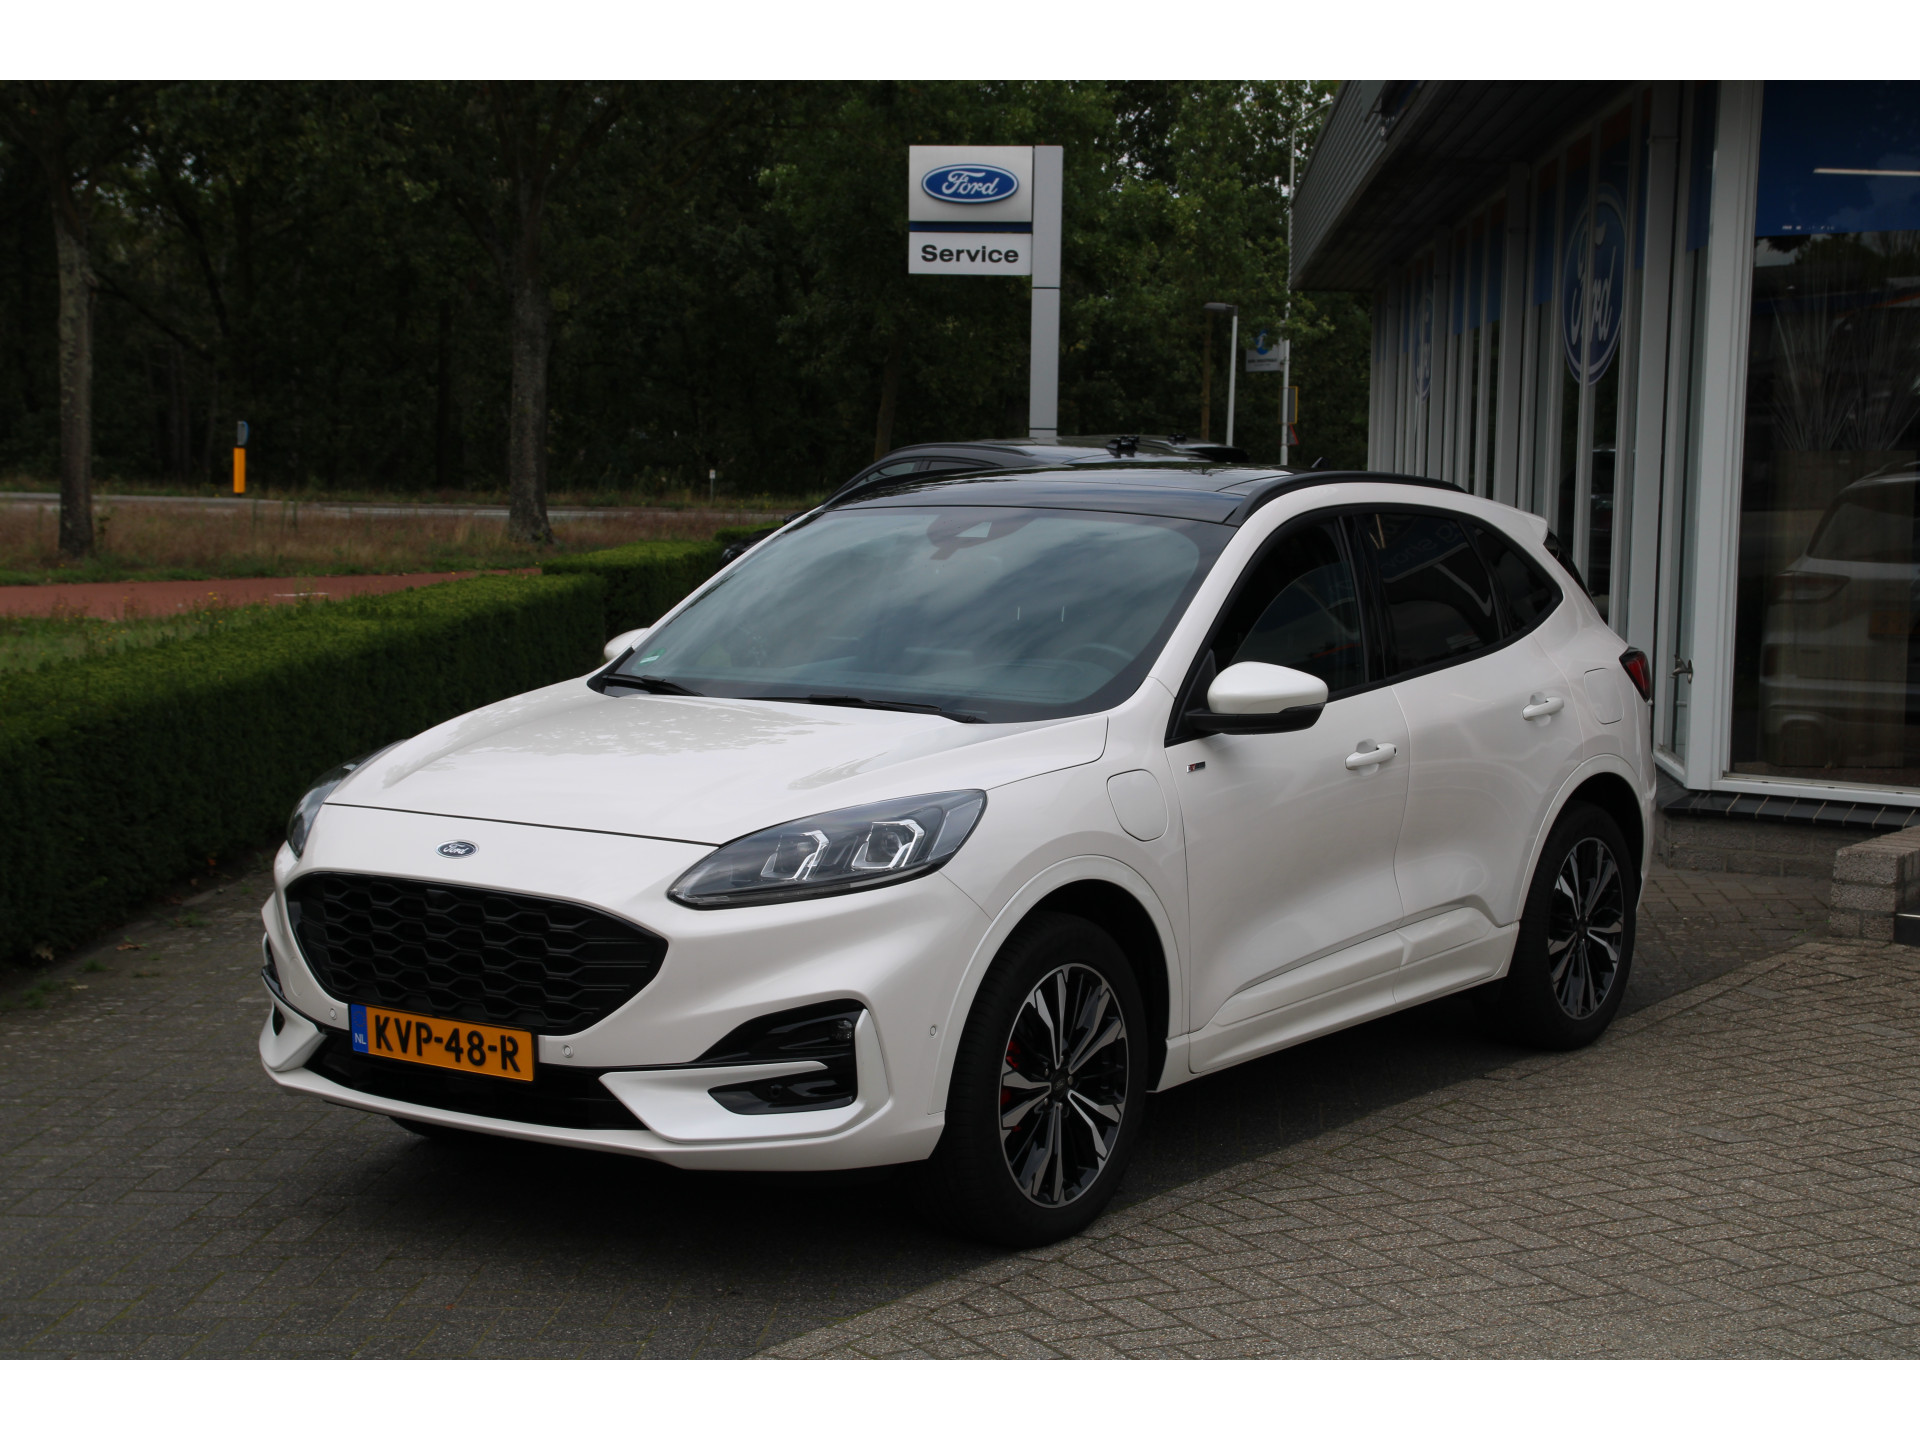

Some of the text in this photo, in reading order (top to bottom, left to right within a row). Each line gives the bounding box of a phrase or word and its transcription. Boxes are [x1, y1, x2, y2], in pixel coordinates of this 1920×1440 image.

[941, 170, 1000, 196] Ford
[921, 244, 1019, 263] Service
[354, 1032, 367, 1045] NL
[374, 1014, 521, 1073] KVP-48-R
